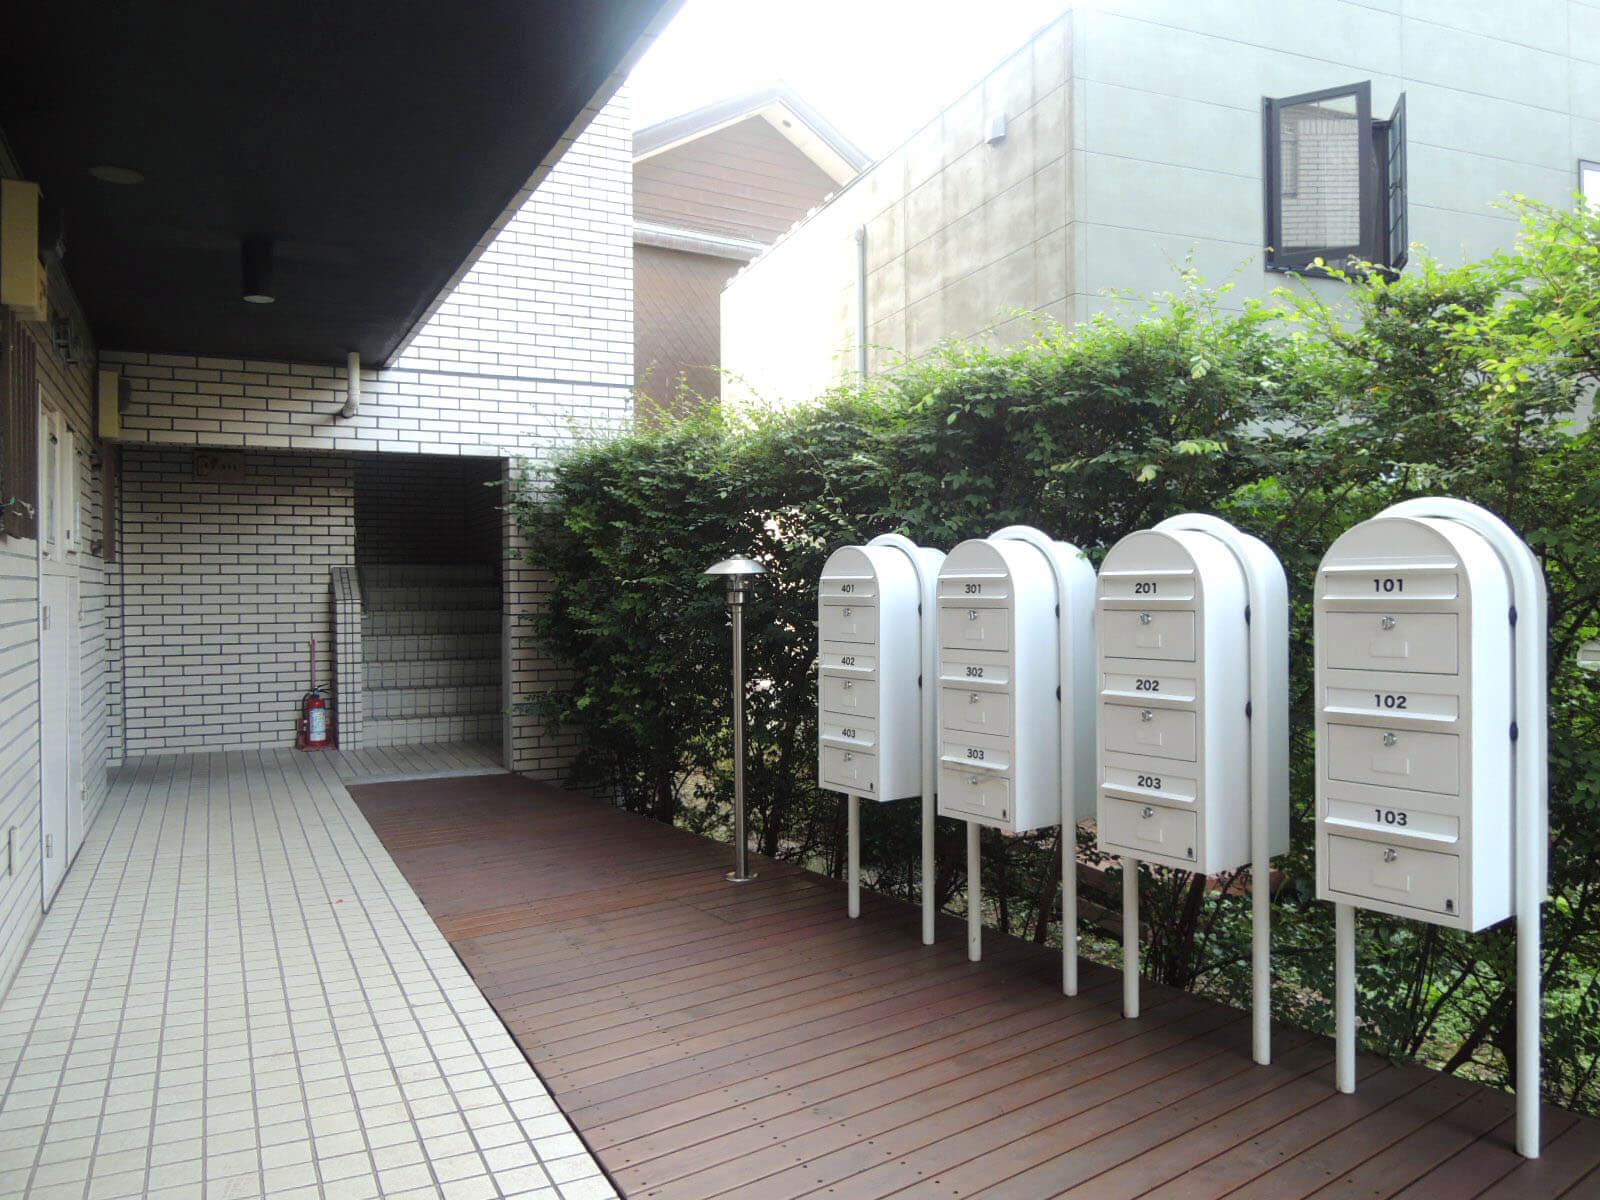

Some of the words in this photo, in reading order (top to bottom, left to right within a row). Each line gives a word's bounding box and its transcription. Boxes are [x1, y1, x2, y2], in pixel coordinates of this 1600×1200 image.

[841, 583, 855, 593] 401
[964, 583, 982, 594] 301
[1135, 582, 1157, 594] 201
[1373, 578, 1403, 593] 101
[841, 656, 855, 667] 402
[966, 666, 984, 678] 302
[1135, 678, 1160, 692] 202
[1374, 694, 1407, 710] 102
[841, 727, 856, 738] 403
[967, 748, 985, 761] 303
[1137, 775, 1161, 790] 203
[1375, 809, 1408, 827] 103
